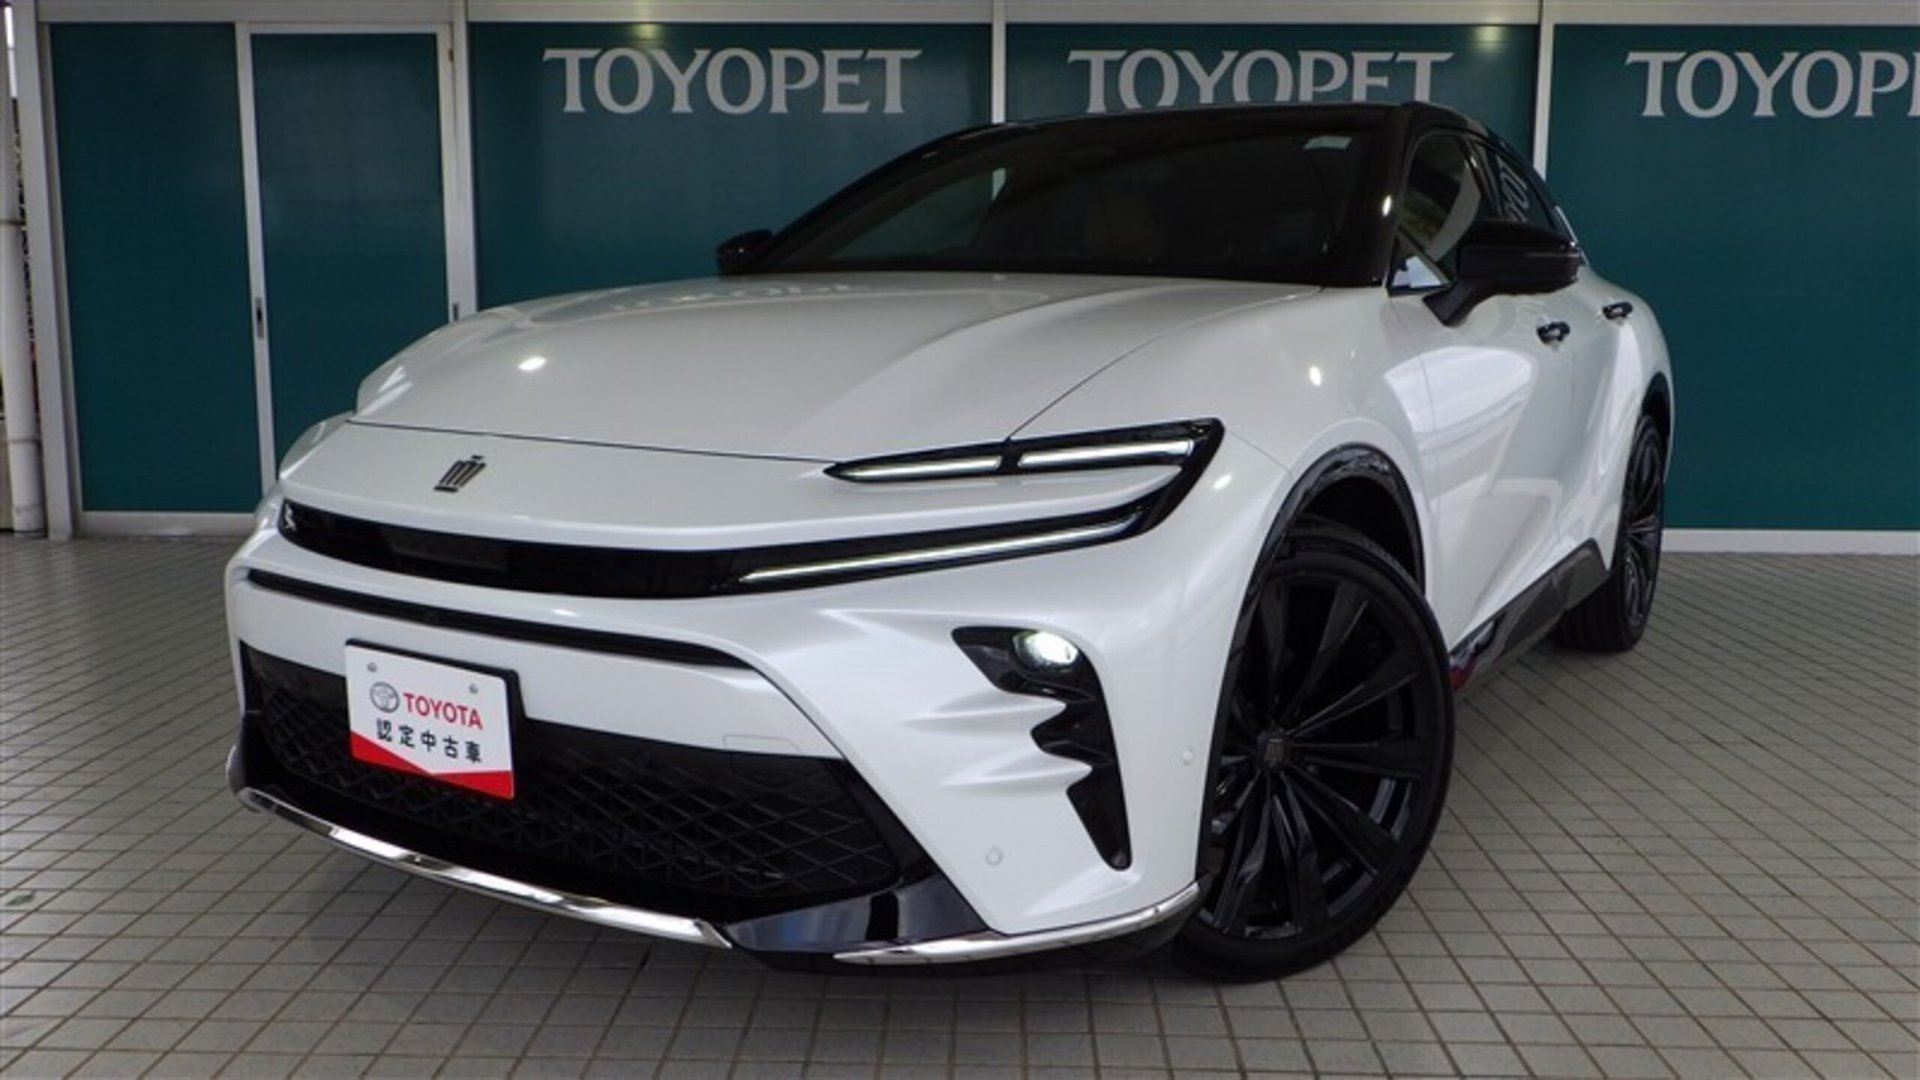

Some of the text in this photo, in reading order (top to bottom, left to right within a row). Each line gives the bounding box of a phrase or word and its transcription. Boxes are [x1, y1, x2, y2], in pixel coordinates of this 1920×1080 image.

[543, 48, 922, 114] TOYOPET
[1626, 51, 1920, 117] TOYOP
[404, 693, 482, 730] TOYOTA
[377, 719, 481, 763] 認定中古車
